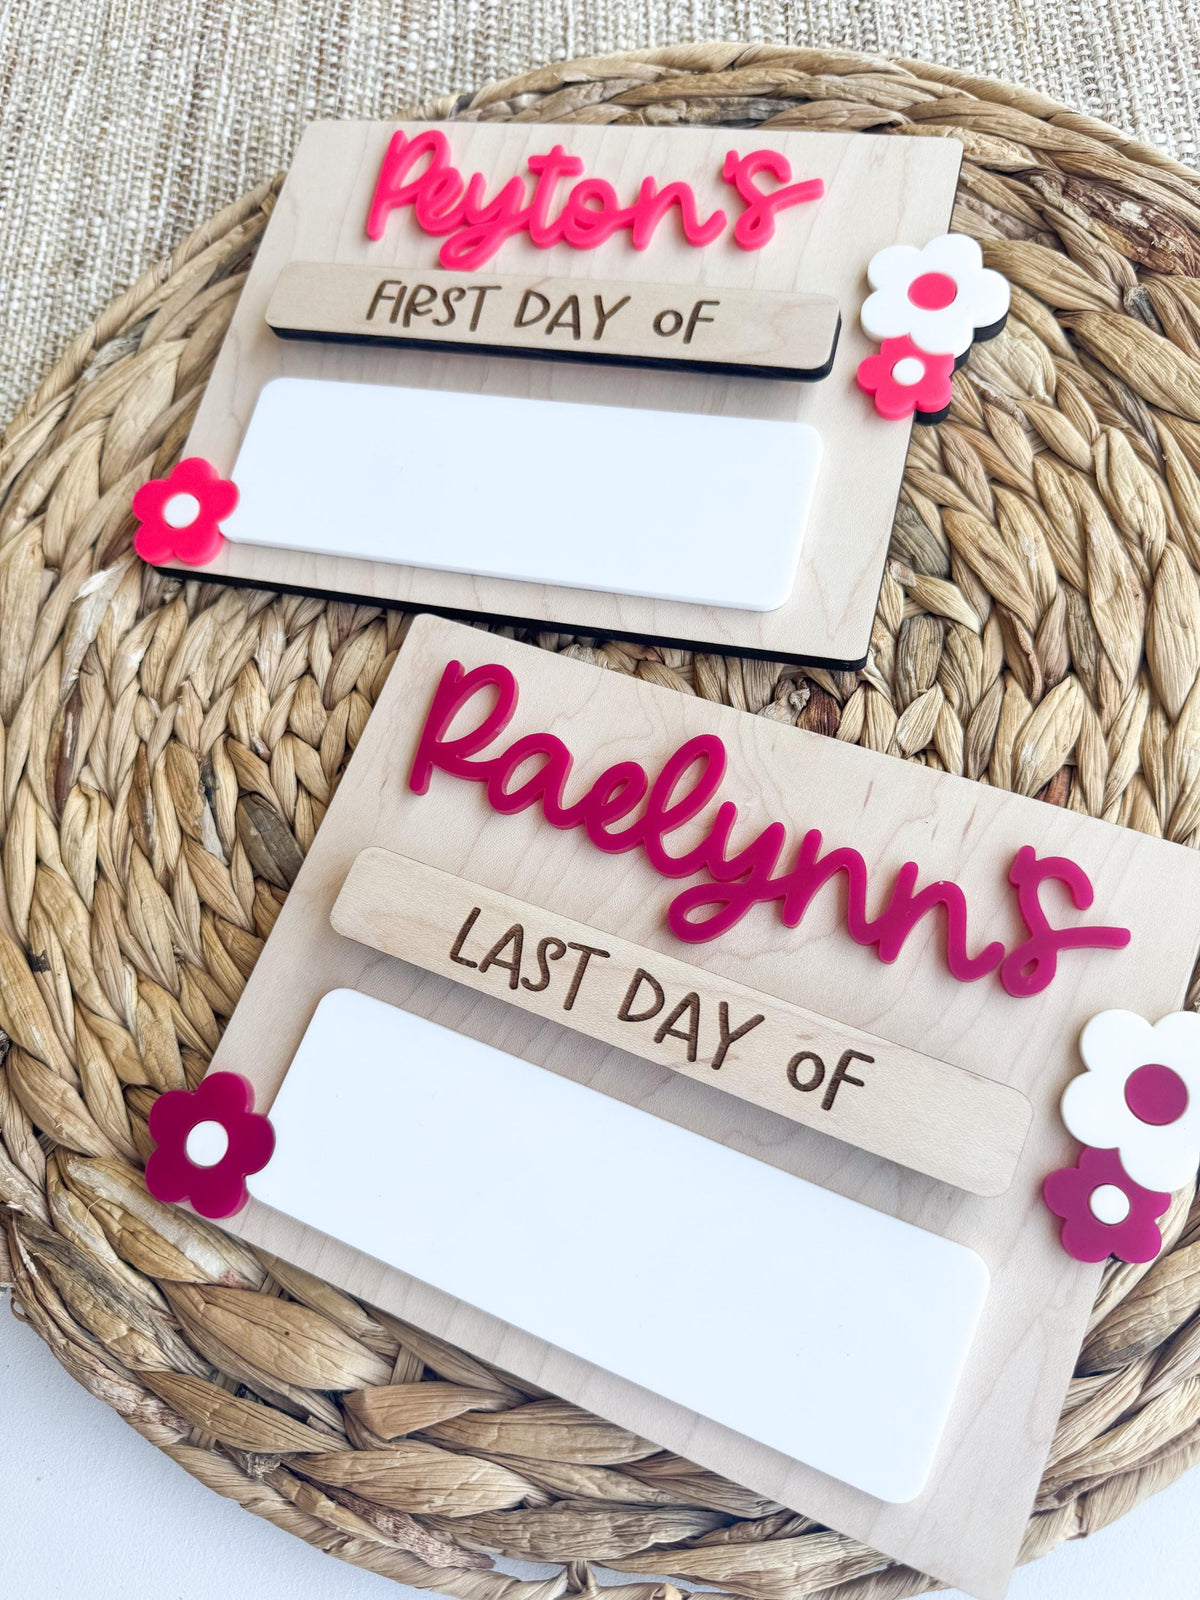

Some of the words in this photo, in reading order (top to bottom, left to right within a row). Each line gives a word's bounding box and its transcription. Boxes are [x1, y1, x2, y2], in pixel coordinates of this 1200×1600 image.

[366, 279, 502, 332] FIRST
[513, 288, 632, 341] DAY
[449, 906, 611, 1012] LAST
[617, 967, 766, 1071] DAY
